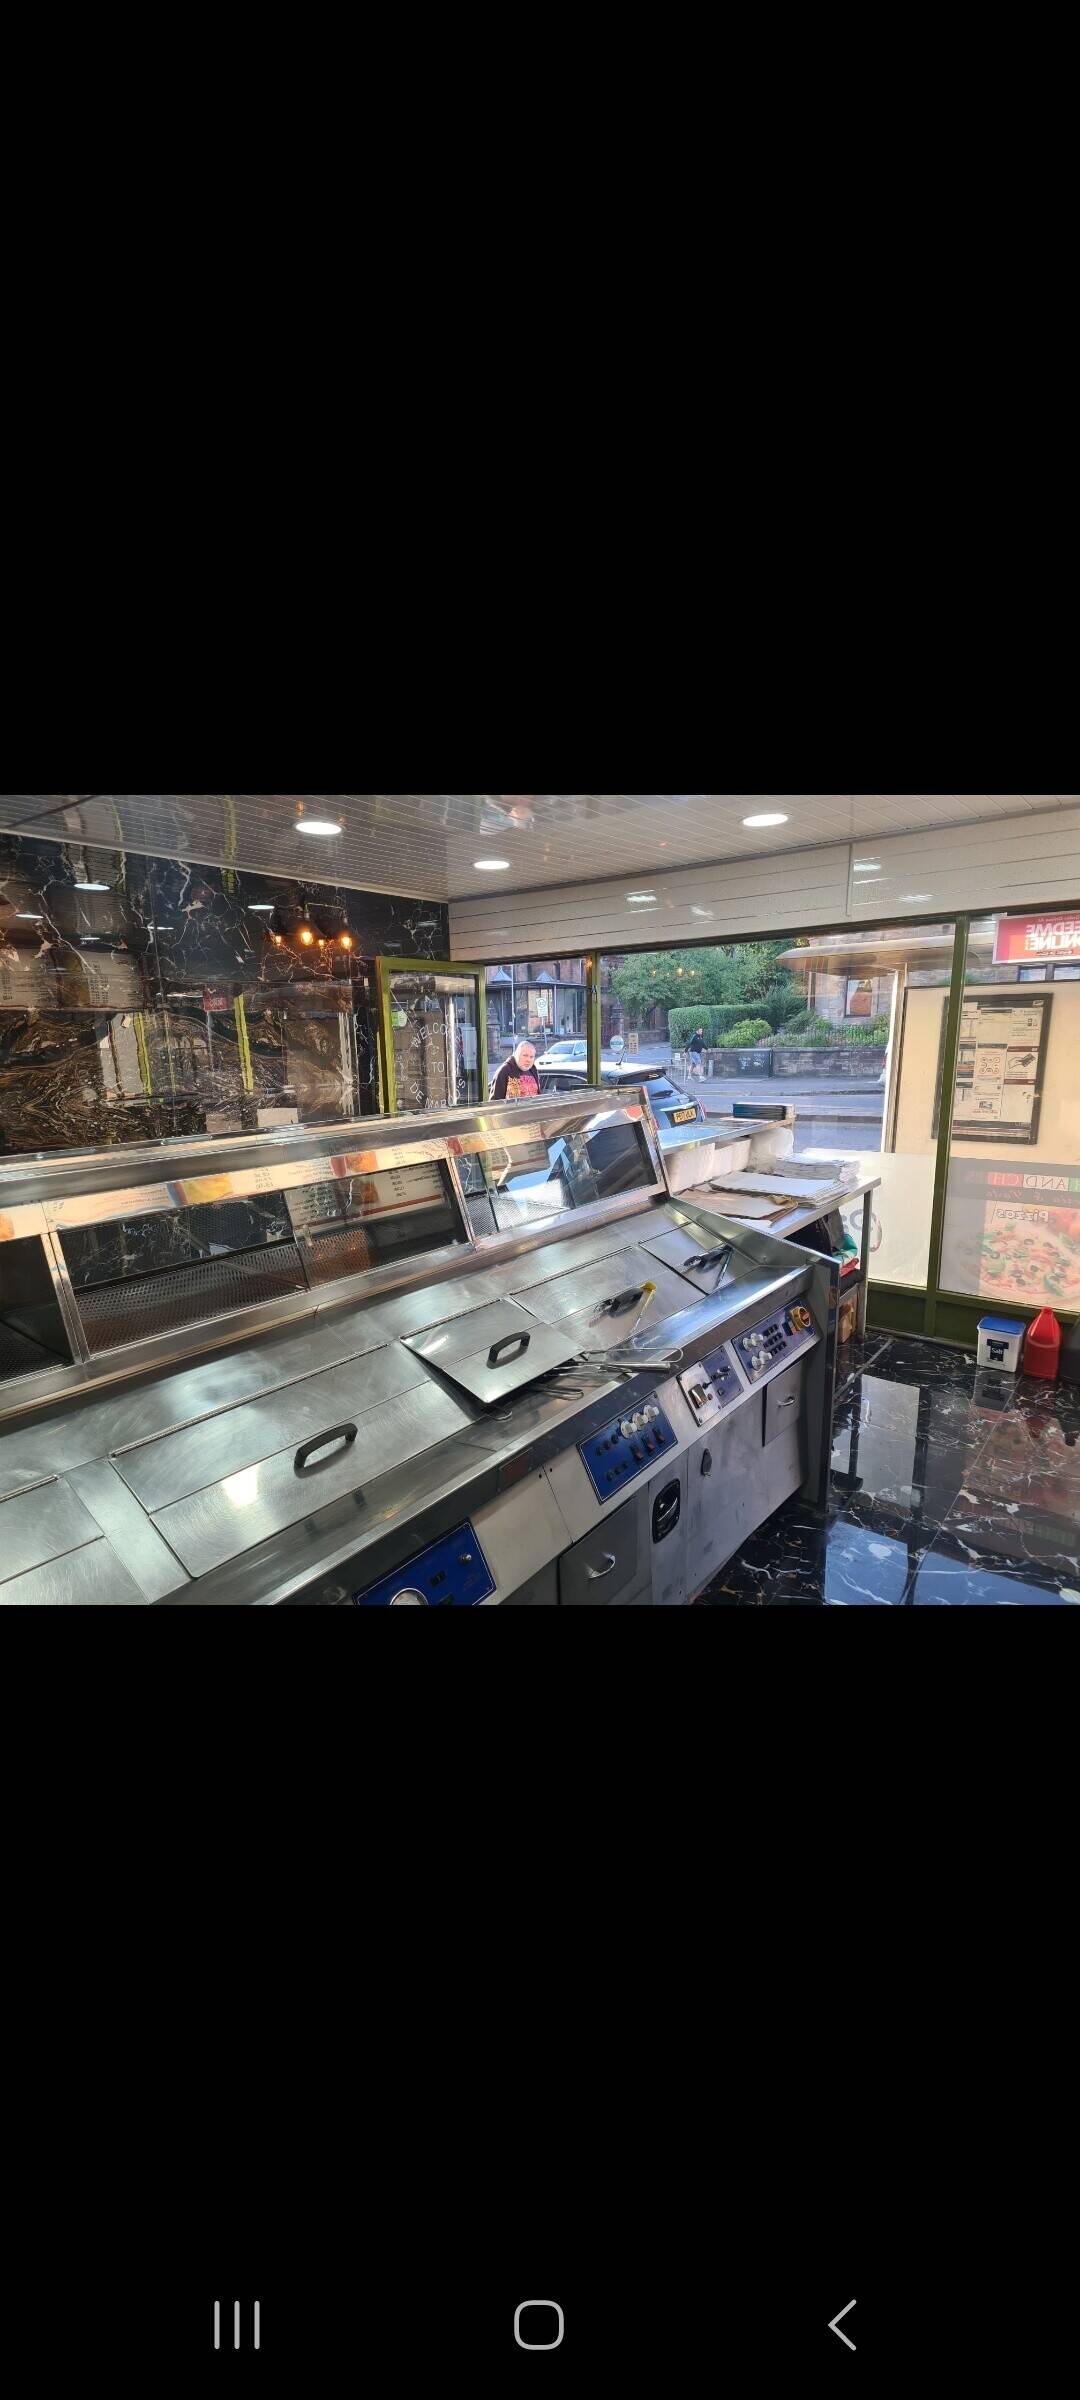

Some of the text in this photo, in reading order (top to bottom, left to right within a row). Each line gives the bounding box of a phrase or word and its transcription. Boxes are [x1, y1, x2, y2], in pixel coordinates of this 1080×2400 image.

[411, 1022, 460, 1048] WELCO
[431, 1061, 445, 1073] TO
[991, 1348, 1004, 1356] Salt
